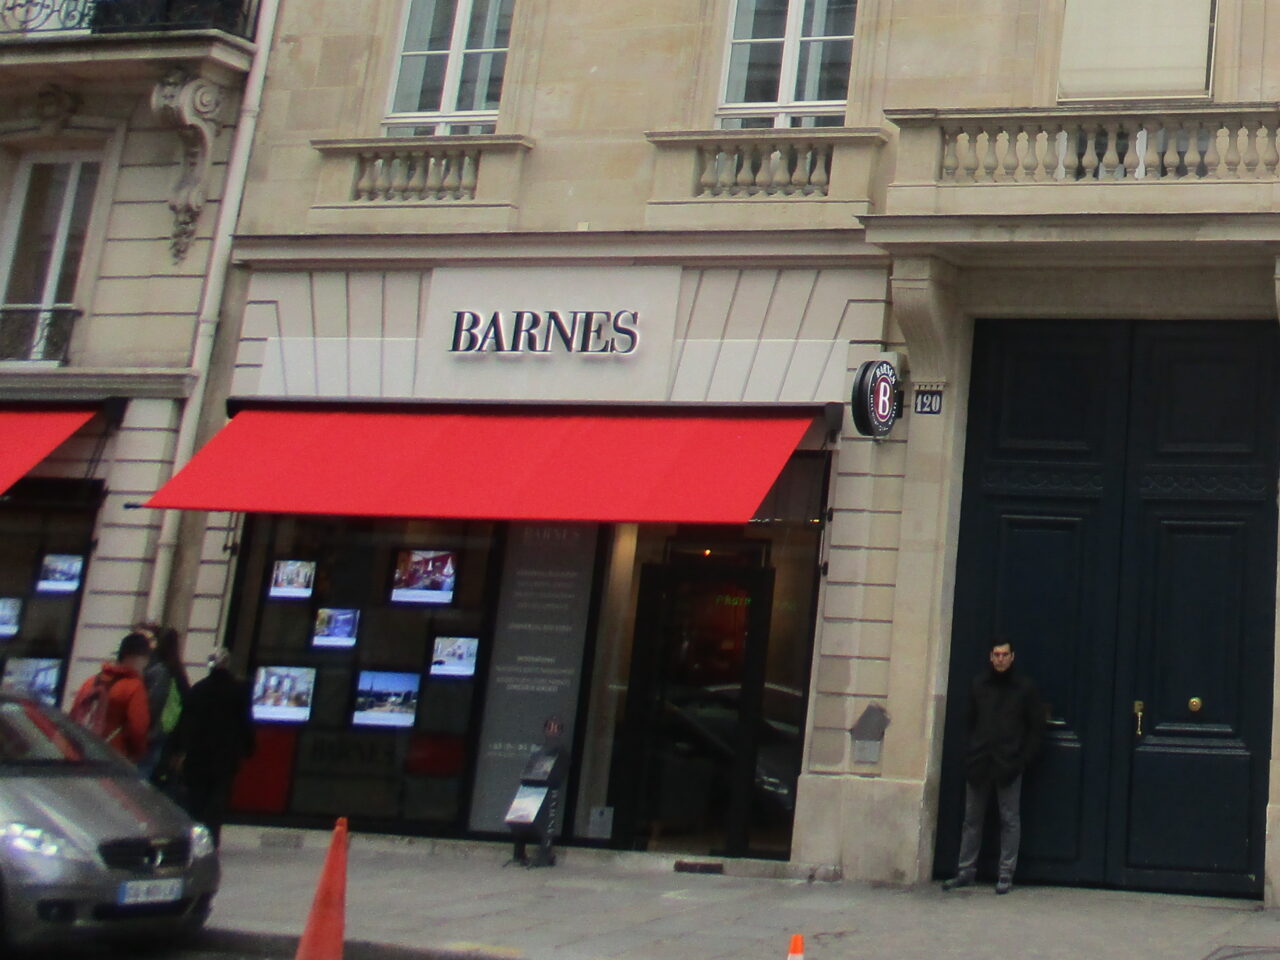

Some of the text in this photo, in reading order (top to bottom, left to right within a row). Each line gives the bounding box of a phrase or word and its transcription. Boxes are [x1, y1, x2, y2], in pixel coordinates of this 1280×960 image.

[448, 310, 640, 354] BARNES
[878, 382, 890, 416] B
[916, 394, 941, 412] 120
